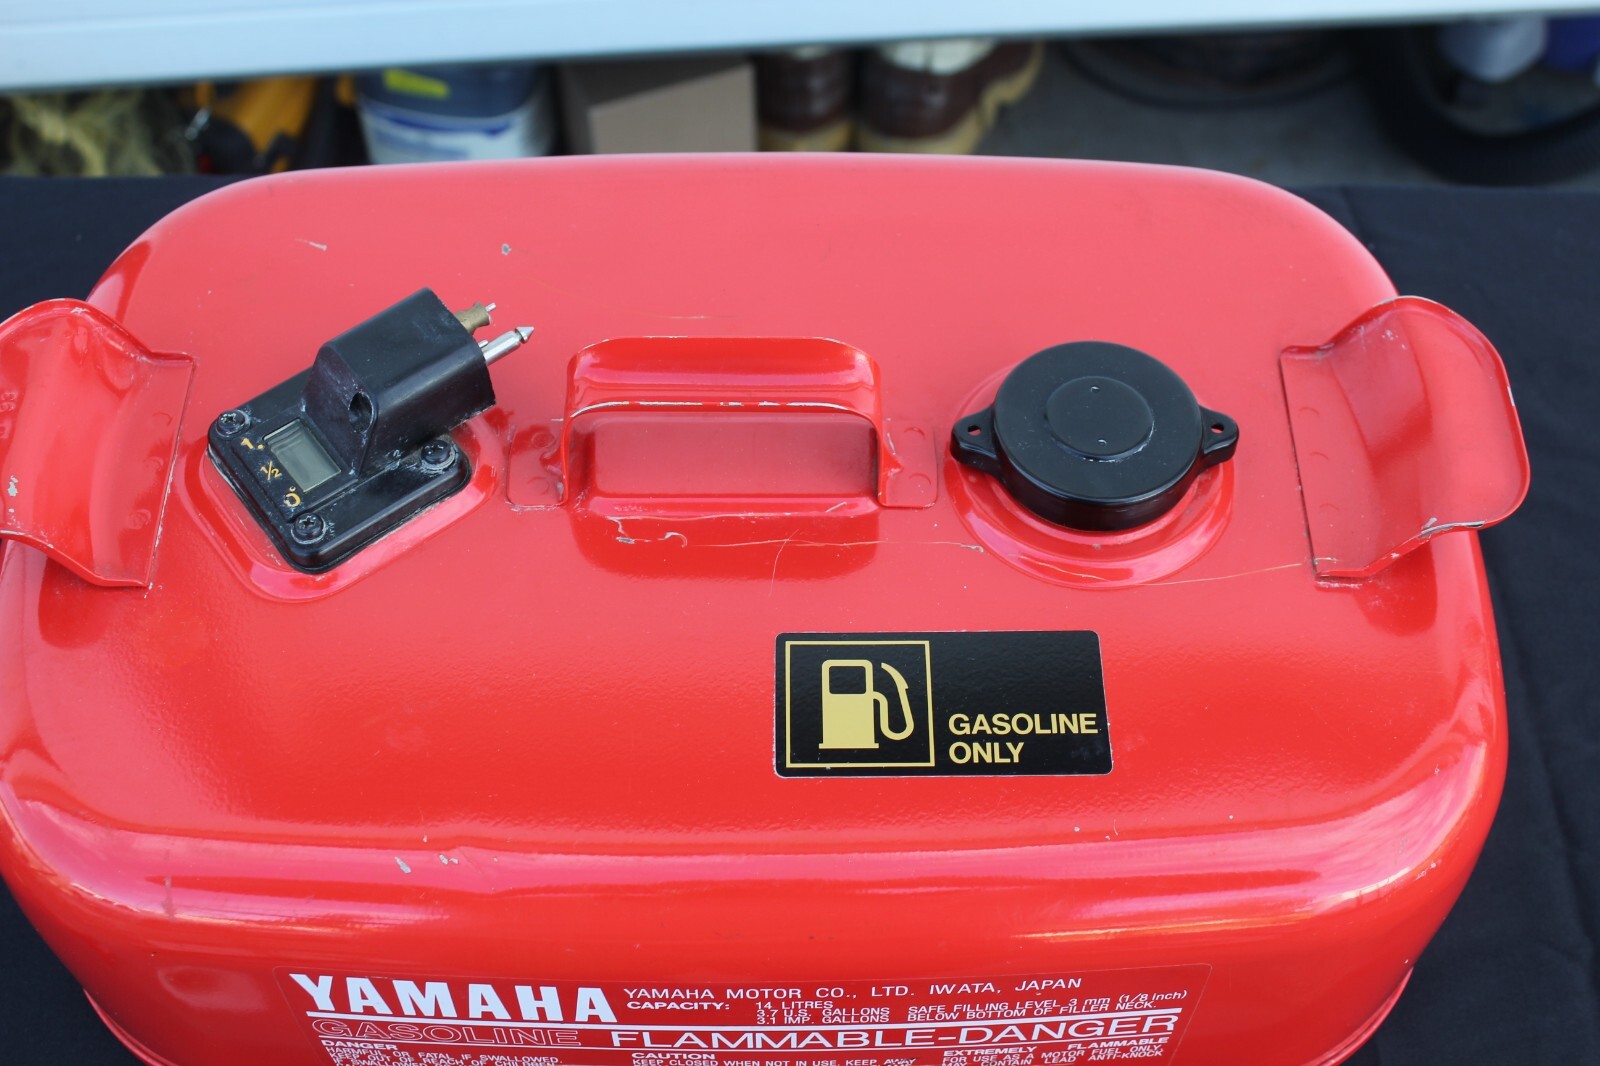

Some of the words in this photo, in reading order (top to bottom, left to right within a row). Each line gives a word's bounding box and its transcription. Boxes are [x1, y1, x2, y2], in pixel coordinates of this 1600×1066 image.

[948, 713, 1098, 735] GASOLINE
[949, 742, 1025, 763] ONLY
[624, 988, 715, 999] YAMAHA
[726, 988, 801, 999] MOTOR
[815, 987, 857, 999] CO.,
[871, 986, 915, 998] LTD.
[929, 982, 1001, 995] IWATA,
[1014, 978, 1082, 991] JAPAN
[289, 973, 618, 1022] YAMAHA
[627, 1001, 731, 1010] CAPACITY:
[755, 1001, 773, 1010] 14
[781, 1000, 833, 1009] LITRES
[908, 1004, 946, 1014] SAFE
[953, 1002, 1009, 1012] FILLING
[1015, 999, 1061, 1010] LEVEL
[1068, 998, 1078, 1007] 3
[1084, 997, 1111, 1006] mm
[1118, 993, 1149, 1004] (1/8
[756, 1009, 779, 1018] 3.7
[783, 1009, 812, 1017] U.S.
[822, 1007, 890, 1016] GALLONS
[907, 1011, 960, 1022] BELOW
[966, 1009, 1027, 1020] BOTTOM
[1033, 1006, 1053, 1016] OF
[1059, 1003, 1109, 1015] FILLER
[1115, 1000, 1157, 1011] NECK.
[756, 1016, 777, 1025] 3.1
[784, 1016, 815, 1024] IMP.
[821, 1015, 890, 1024] GALLONS
[312, 1019, 582, 1046] GASOLINE
[611, 1015, 1179, 1048] FLAMMABLE-DANGER
[321, 1039, 399, 1051] DANGER
[943, 1046, 1037, 1057] EXTREMELY
[1067, 1036, 1170, 1051] FLAMMABLE
[392, 1050, 411, 1058] OR
[418, 1051, 455, 1061] FATAL
[631, 1052, 716, 1060] CAUTION
[942, 1056, 967, 1064] FOR
[973, 1054, 998, 1063] USE
[1003, 1053, 1020, 1061] AS
[1025, 1052, 1035, 1060] A
[1041, 1049, 1086, 1060] MOTOR
[1091, 1047, 1122, 1056] FUEL
[1043, 1056, 1077, 1064] LEAD
[1087, 1050, 1163, 1062] ANTI-KNOCK
